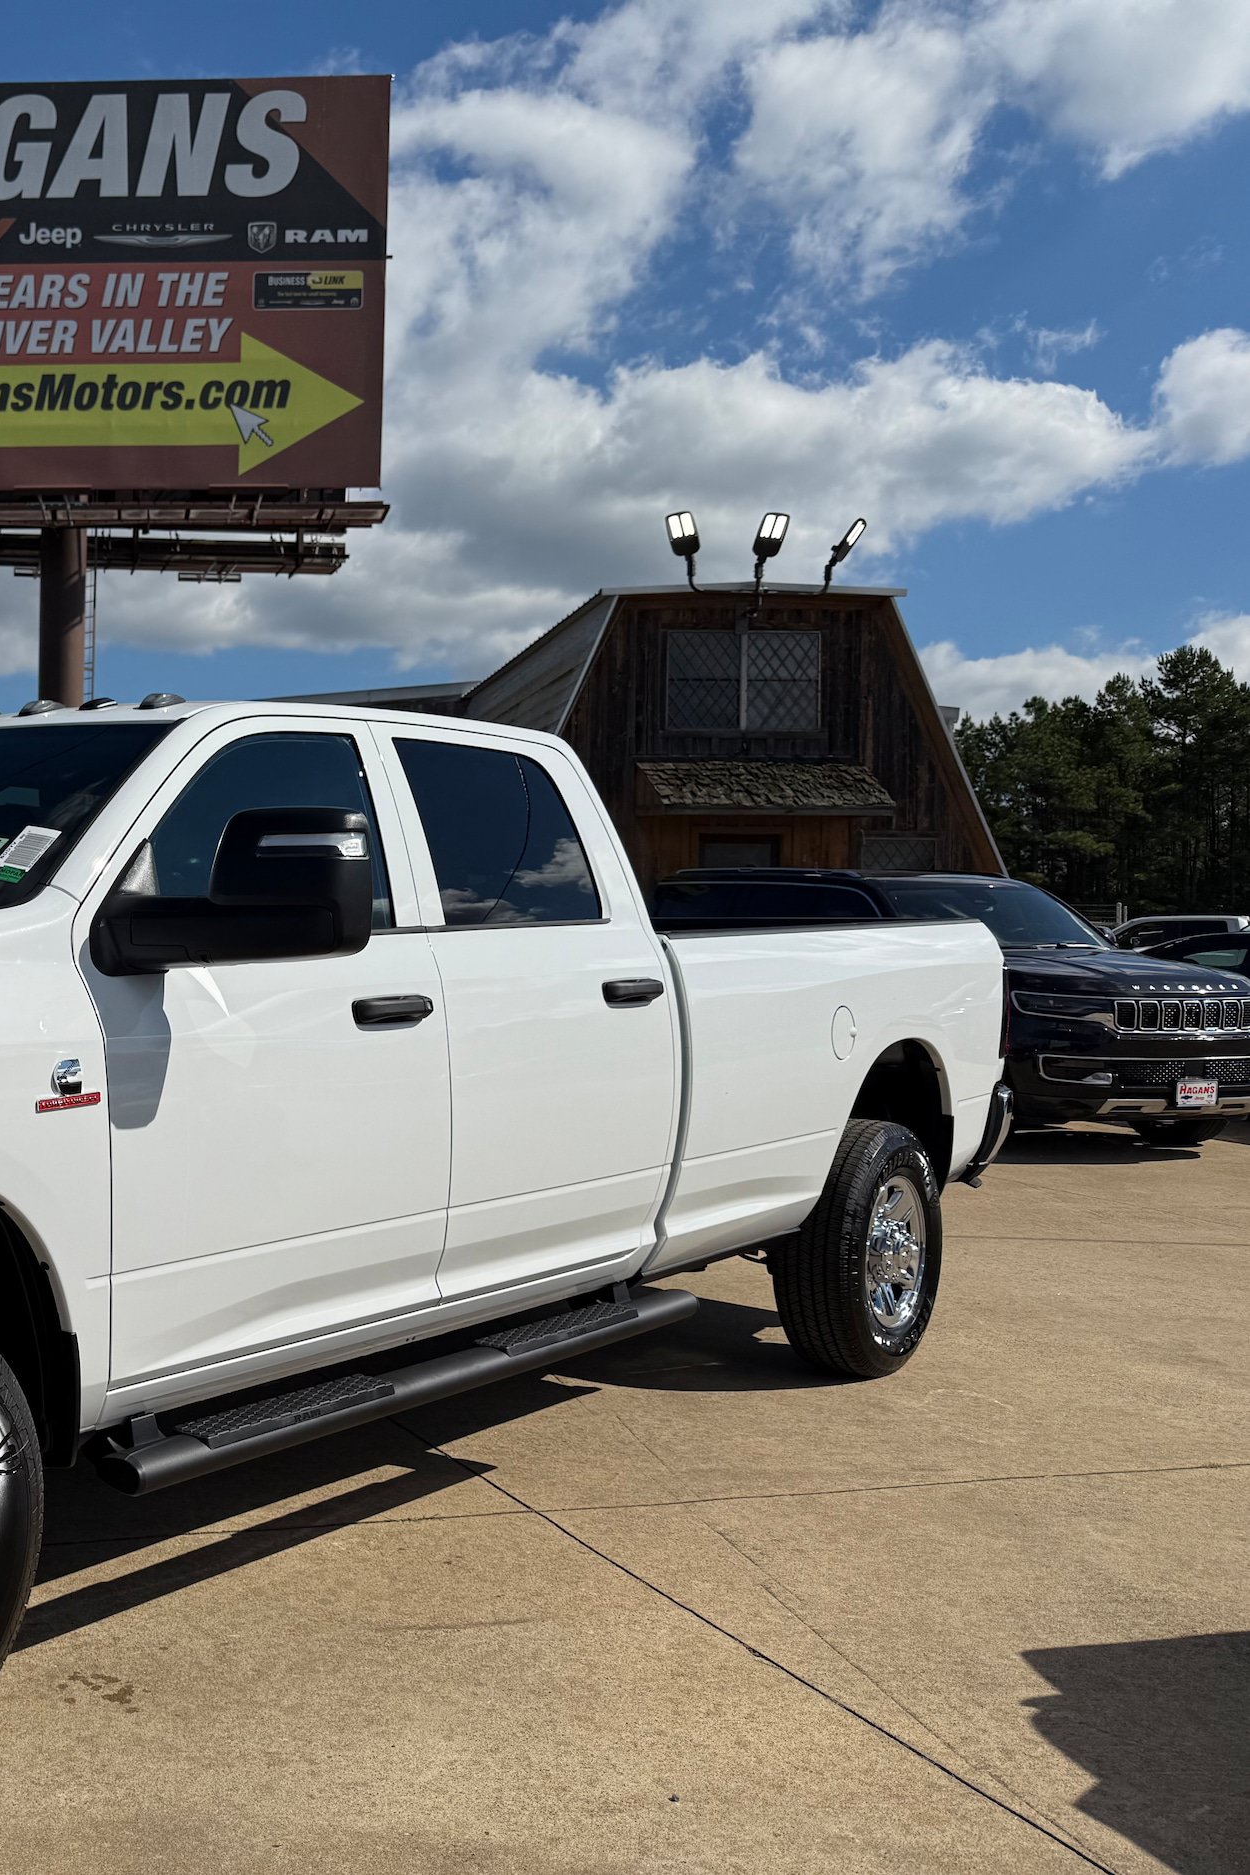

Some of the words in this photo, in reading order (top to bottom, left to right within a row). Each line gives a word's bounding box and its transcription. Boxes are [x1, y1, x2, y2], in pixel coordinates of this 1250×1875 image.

[19, 222, 82, 248] Jeep
[112, 223, 215, 232] CHRYSLER
[284, 228, 368, 243] RAM
[102, 273, 145, 308] IN
[157, 271, 229, 307] THE
[268, 275, 305, 286] BUSINESS
[323, 275, 346, 285] LINK
[91, 317, 234, 354] VALLEY
[1179, 1083, 1215, 1094] HAGANS
[292, 1408, 321, 1421] RAM
